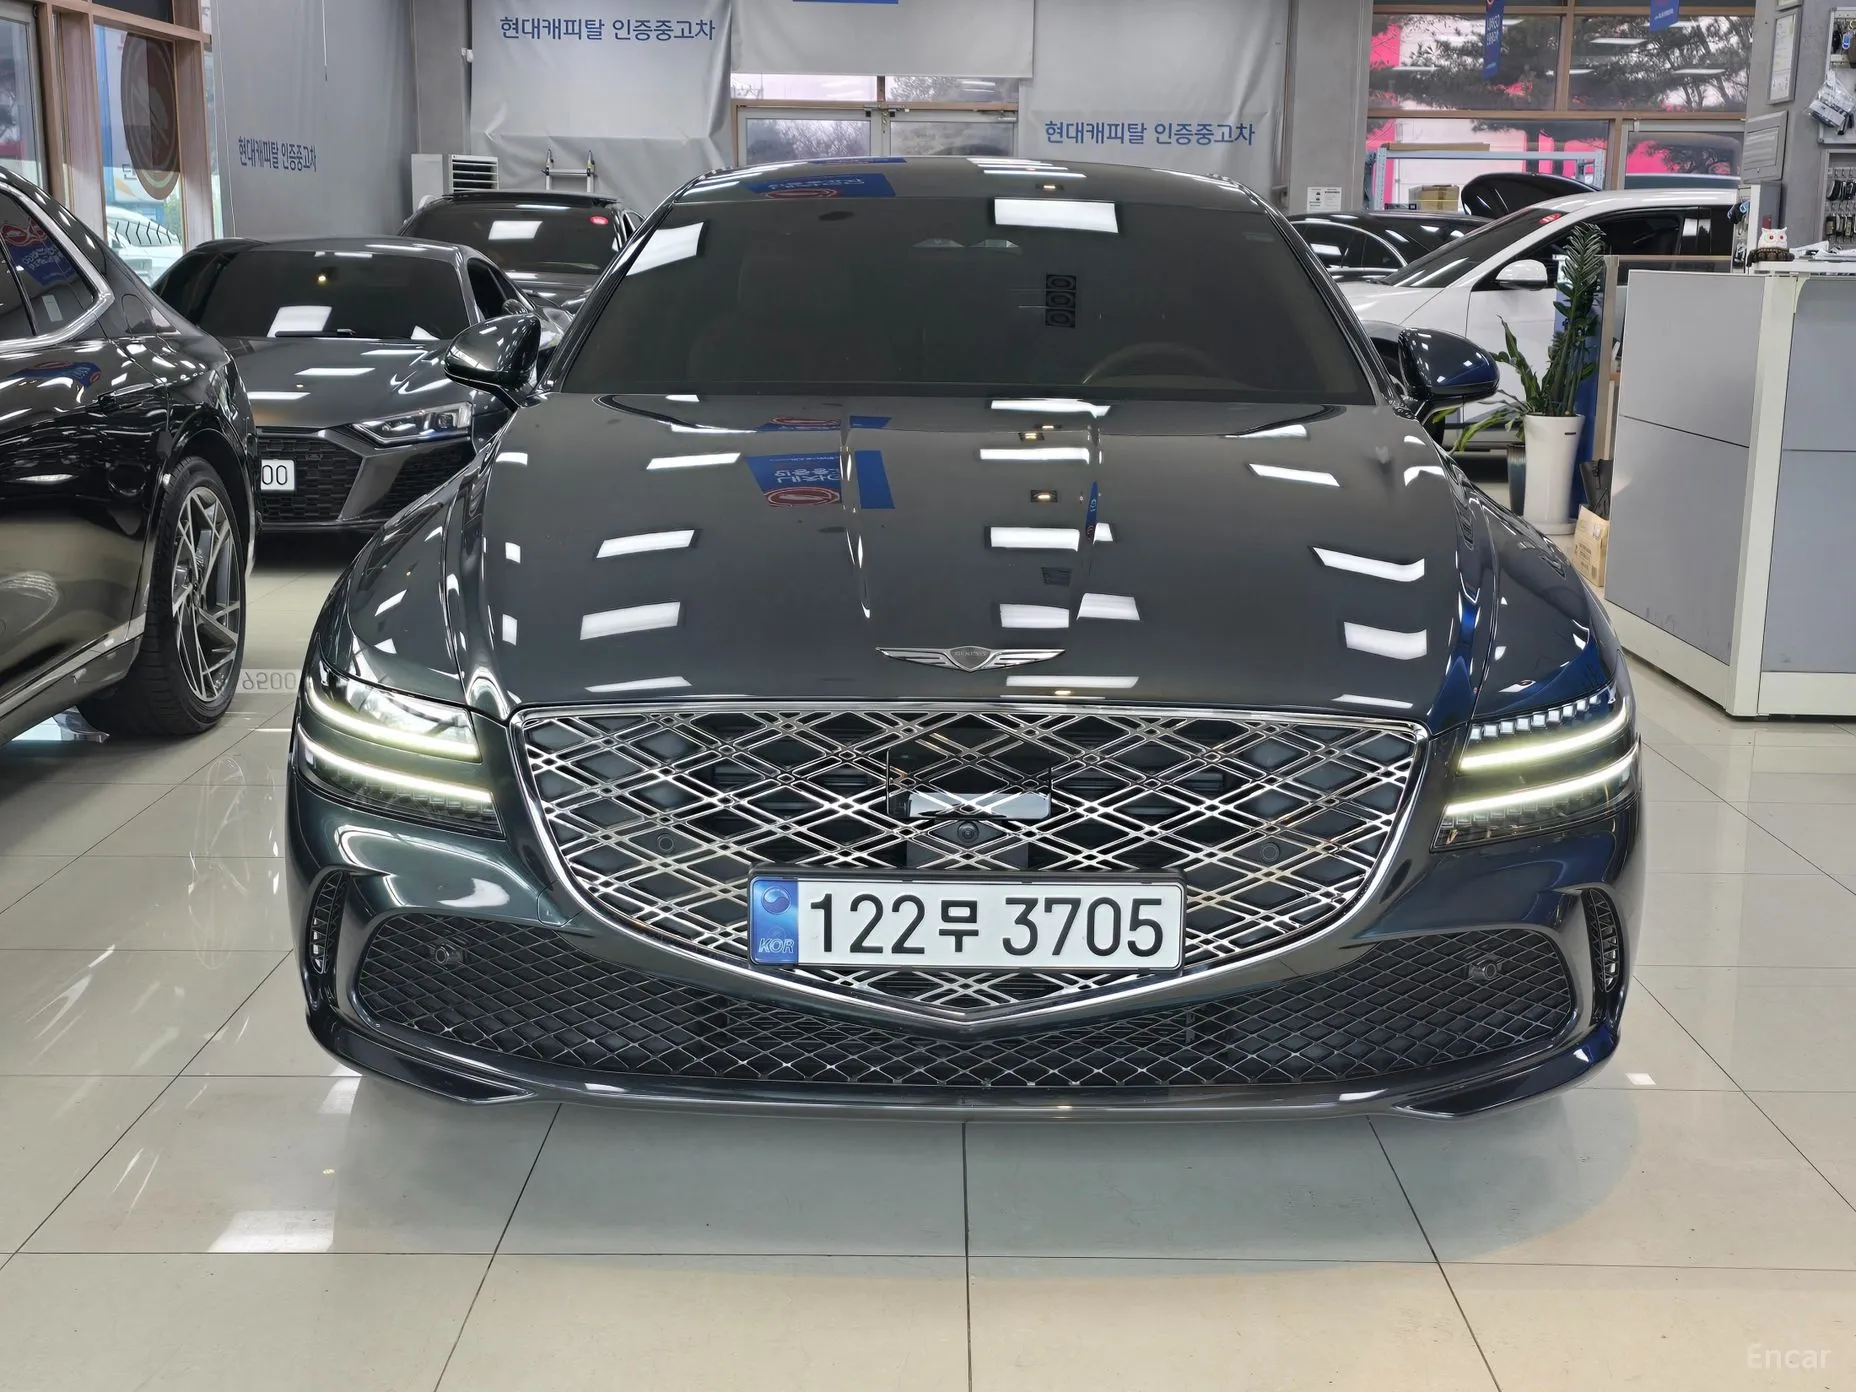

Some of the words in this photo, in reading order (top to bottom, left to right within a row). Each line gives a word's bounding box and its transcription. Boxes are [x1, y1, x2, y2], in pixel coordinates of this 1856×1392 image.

[500, 16, 605, 40] 현대캐피탈
[612, 19, 716, 41] 인증중고차
[1045, 121, 1147, 145] 현대캐피탈
[1154, 123, 1256, 146] 인증중고차
[238, 136, 279, 169] 현대캐피탈
[281, 142, 317, 172] 인증중고차
[810, 893, 979, 955] 122무
[1002, 897, 1164, 957] 3705
[759, 937, 795, 954] KOR
